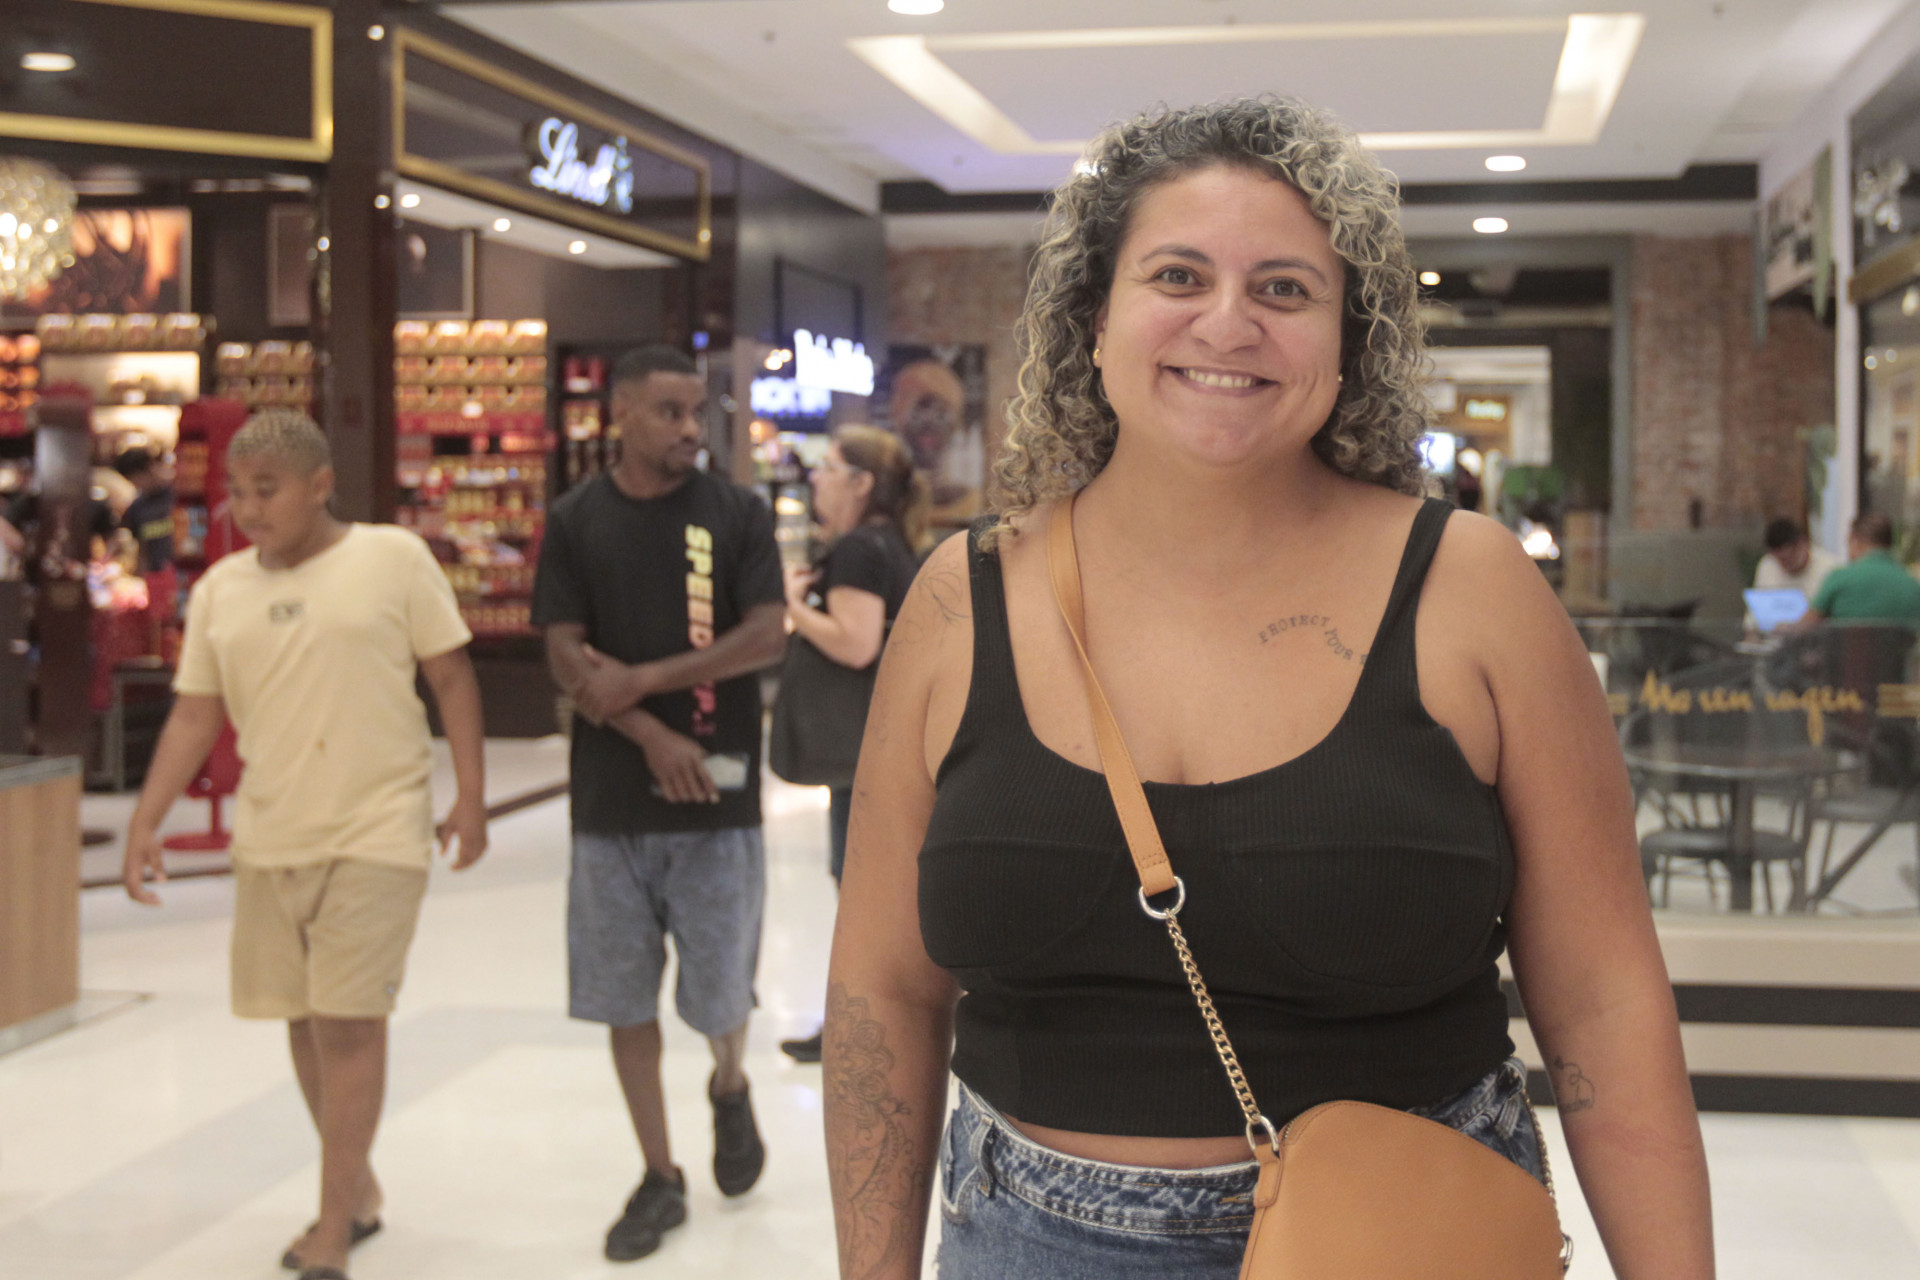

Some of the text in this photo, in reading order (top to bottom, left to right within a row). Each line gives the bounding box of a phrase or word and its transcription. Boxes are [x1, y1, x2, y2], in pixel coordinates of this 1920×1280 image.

[685, 523, 714, 649] SPEED
[1259, 614, 1330, 644] PROTECT
[1325, 627, 1354, 660] YOUR
